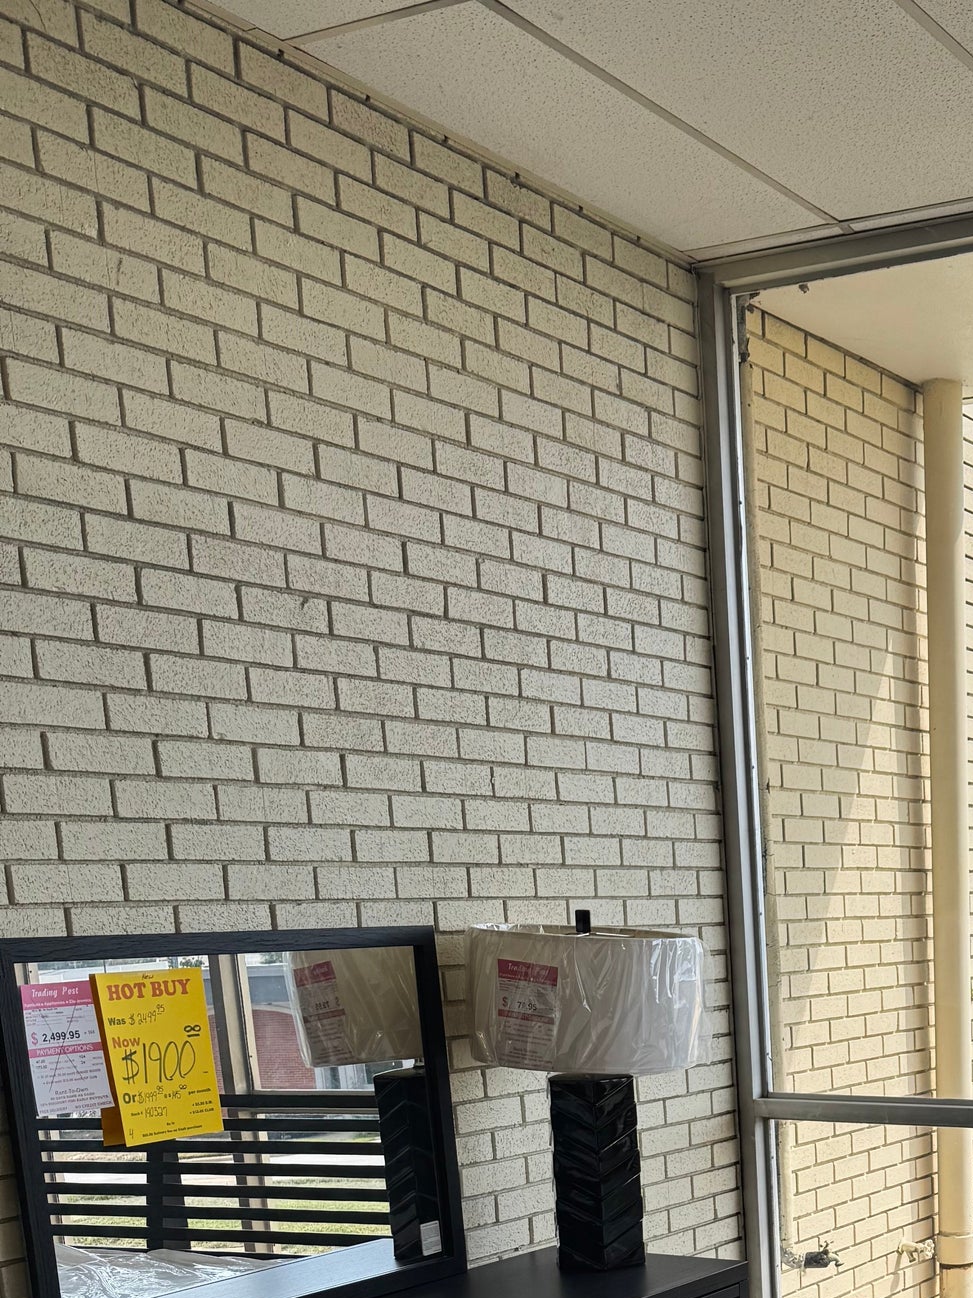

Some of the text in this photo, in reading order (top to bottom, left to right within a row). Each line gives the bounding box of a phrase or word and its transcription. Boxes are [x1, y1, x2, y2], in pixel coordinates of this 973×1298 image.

[31, 986, 79, 998] Trading Post
[106, 978, 191, 1001] HOT BUY
[107, 1017, 127, 1026] Was
[31, 1031, 39, 1047] $
[42, 1030, 81, 1044] 2,499.95
[111, 1036, 141, 1049] Now
[36, 1043, 94, 1057] PAYMENT OPTIONS
[122, 1092, 137, 1104] Or
